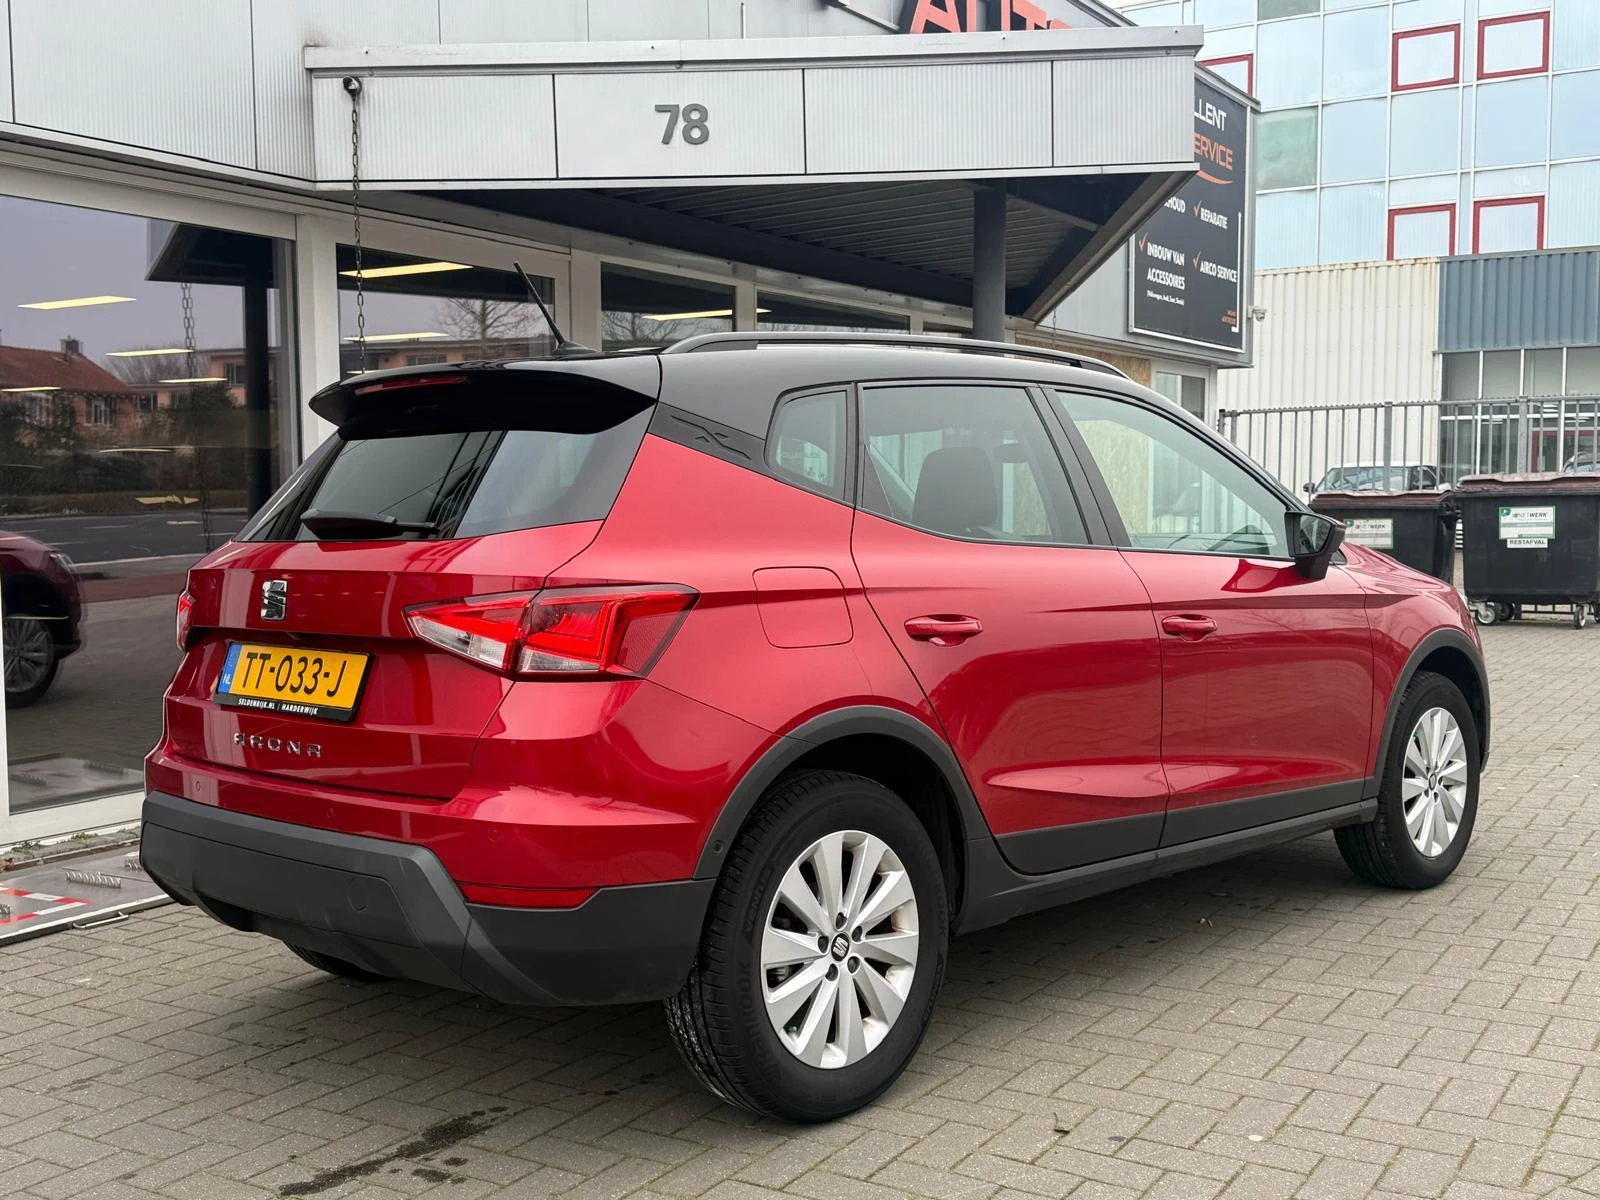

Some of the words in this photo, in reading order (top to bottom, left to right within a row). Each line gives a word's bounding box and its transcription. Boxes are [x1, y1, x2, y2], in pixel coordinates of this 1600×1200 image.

[655, 103, 709, 145] 78
[1200, 207, 1228, 230] REPARATIE
[1147, 241, 1172, 262] INBOUW
[1172, 250, 1185, 267] VAN
[1146, 267, 1185, 290] ACCESSOIRES
[1200, 260, 1217, 277] AIRCO
[1217, 265, 1237, 283] SERVICE
[222, 673, 232, 685] NL
[242, 651, 348, 698] TT-033-J
[233, 732, 322, 758] ARONA
